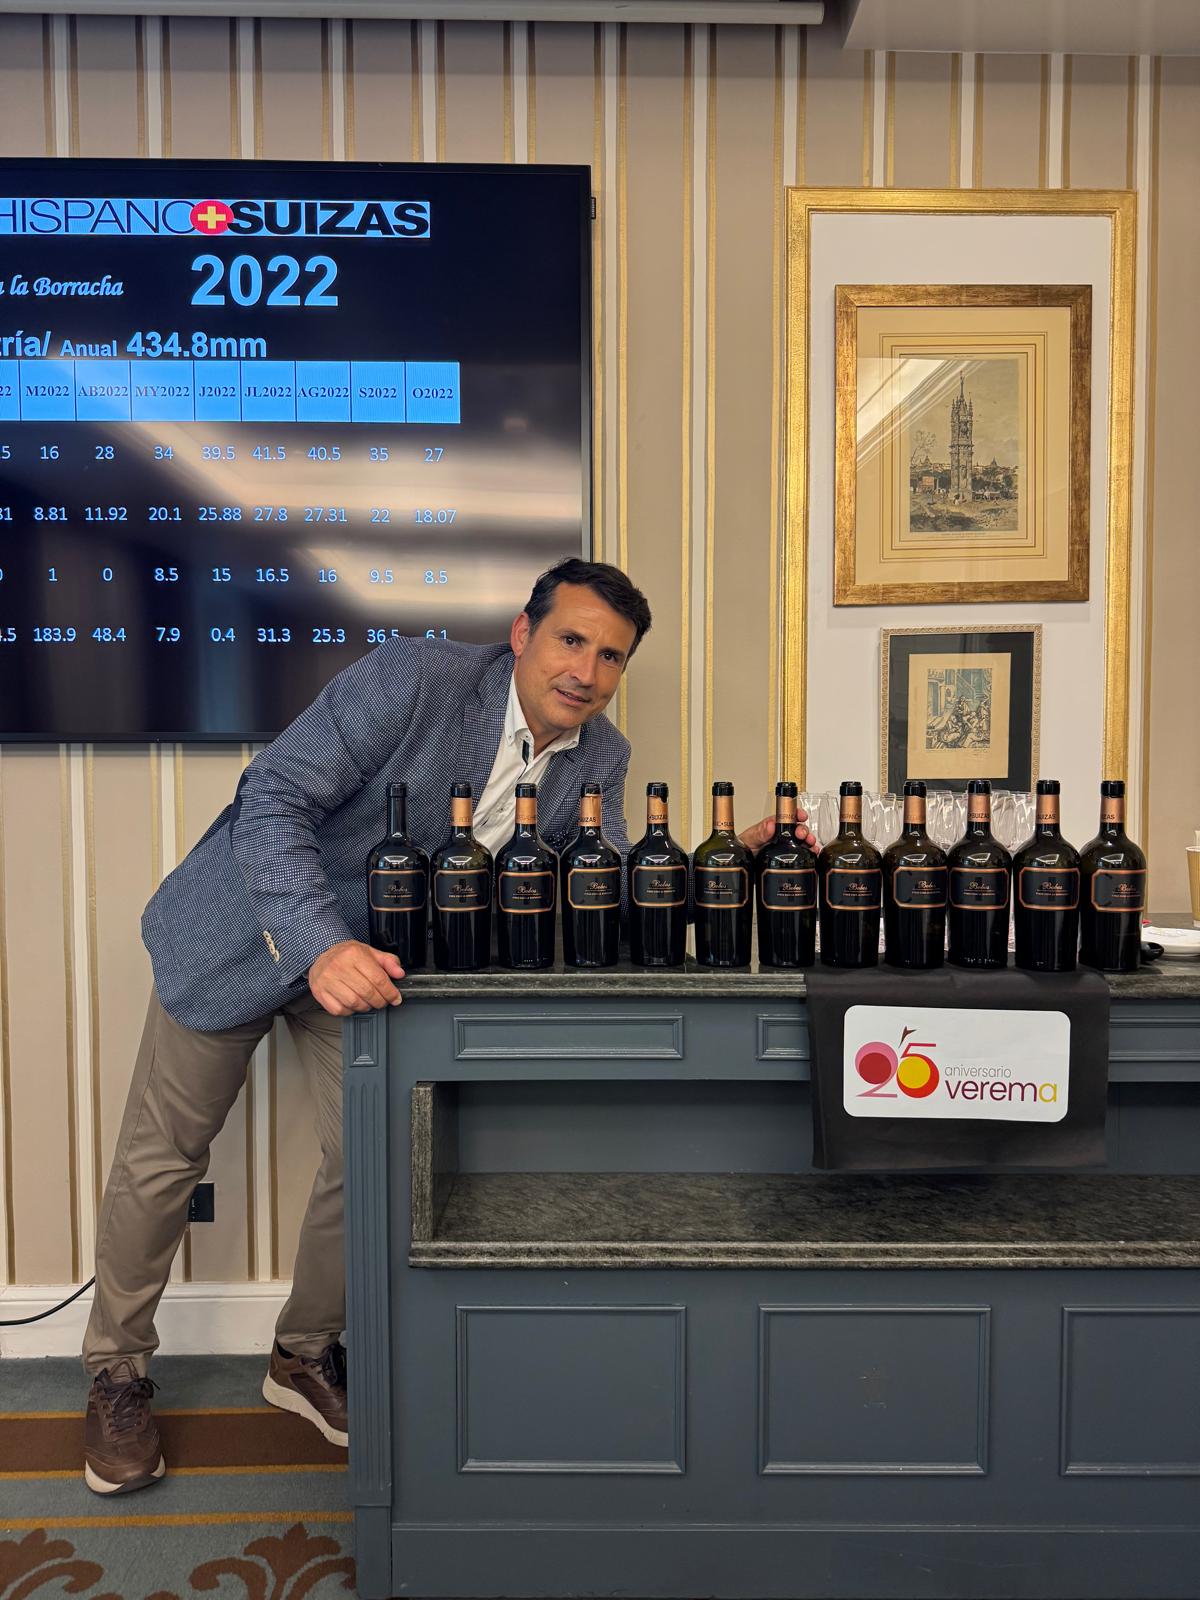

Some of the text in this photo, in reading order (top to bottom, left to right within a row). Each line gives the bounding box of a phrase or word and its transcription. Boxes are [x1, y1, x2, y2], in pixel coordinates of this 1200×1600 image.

[227, 201, 429, 236] SUIZAS
[10, 275, 28, 296] la
[33, 275, 124, 296] Borracha
[191, 254, 339, 307] 2022
[0, 331, 267, 358] ría/ Anual 434.8mm
[26, 386, 70, 397] M2022
[78, 386, 128, 397] AB2022
[136, 386, 190, 397] MY2022
[199, 386, 236, 398] J2022
[245, 386, 292, 398] JL2022
[297, 386, 349, 399] AG2022
[359, 387, 397, 399] S2022
[412, 387, 454, 399] O2022
[40, 445, 60, 460] 16
[95, 445, 115, 460] 28
[154, 446, 174, 460] 34
[202, 446, 236, 460] 39.5
[252, 446, 286, 460] 41.5
[307, 446, 341, 461] 40.5
[370, 447, 389, 461] 35
[424, 447, 444, 462] 27
[34, 507, 68, 521] 8.81
[85, 507, 128, 521] 11.92
[149, 507, 182, 521] 20.1
[198, 507, 242, 521] 25.88
[254, 507, 288, 521] 27.8
[304, 508, 347, 522] 27.31
[371, 509, 390, 523] 22
[415, 509, 457, 523] 18.07
[48, 567, 448, 584] 1 0 8.5 15 16.5 16 9.5 8.5
[33, 627, 76, 642] 183.9
[92, 627, 126, 642] 48.4
[156, 627, 181, 642] 7.9
[211, 627, 236, 642] 0.4
[257, 628, 291, 643] 31.3
[312, 628, 345, 643] 25.3
[366, 629, 400, 643] 365
[855, 1041, 940, 1099] 25
[944, 1064, 1012, 1079] aniversario
[944, 1079, 1058, 1103] verema
